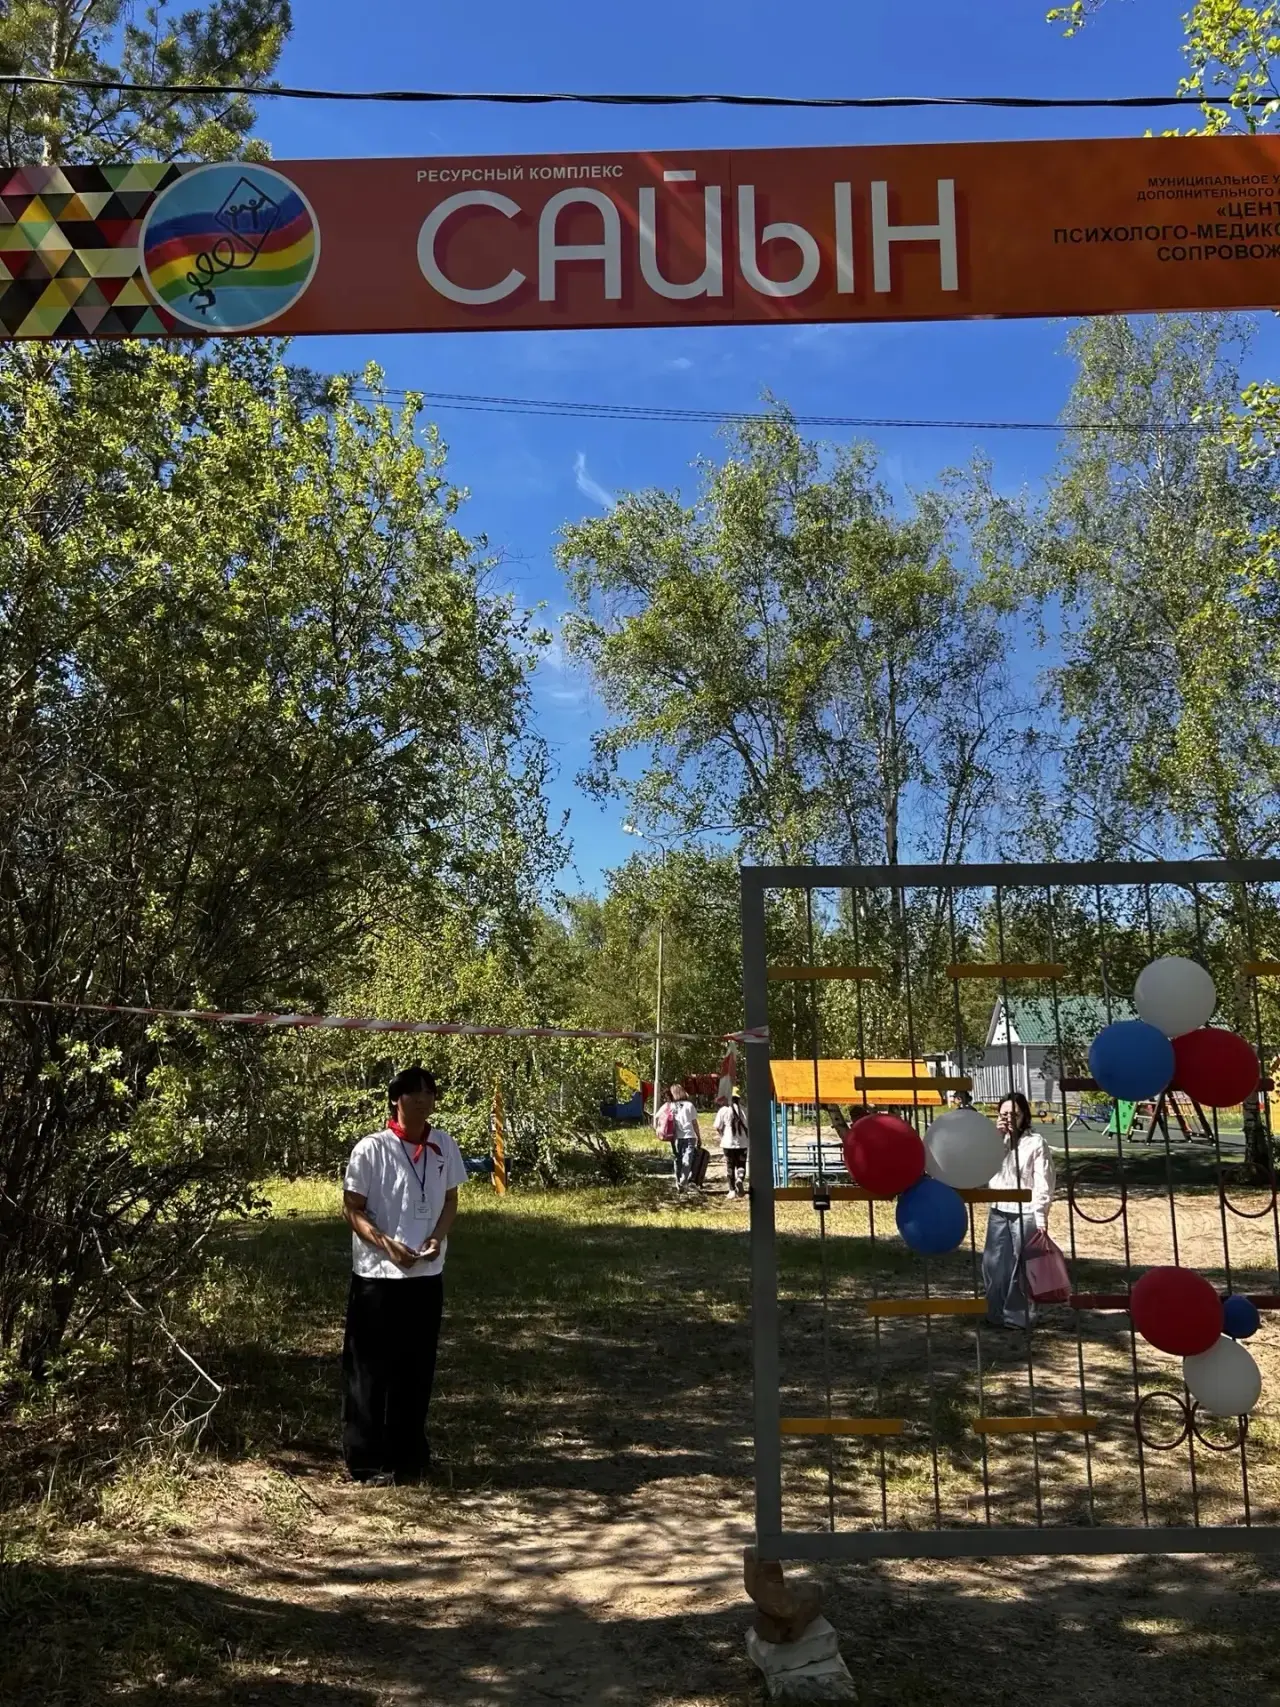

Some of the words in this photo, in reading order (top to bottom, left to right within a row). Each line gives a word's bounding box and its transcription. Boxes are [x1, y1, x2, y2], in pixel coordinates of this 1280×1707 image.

[416, 165, 524, 182] РЕСУРСНЫЙ
[529, 165, 623, 180] КОМПЛЕКС
[1148, 175, 1269, 187] МУНИЦИПАЛЬНОЕ
[1137, 187, 1274, 201] ДОПОЛНИТЕЛЬНОГО
[417, 170, 958, 305] САЙЫН
